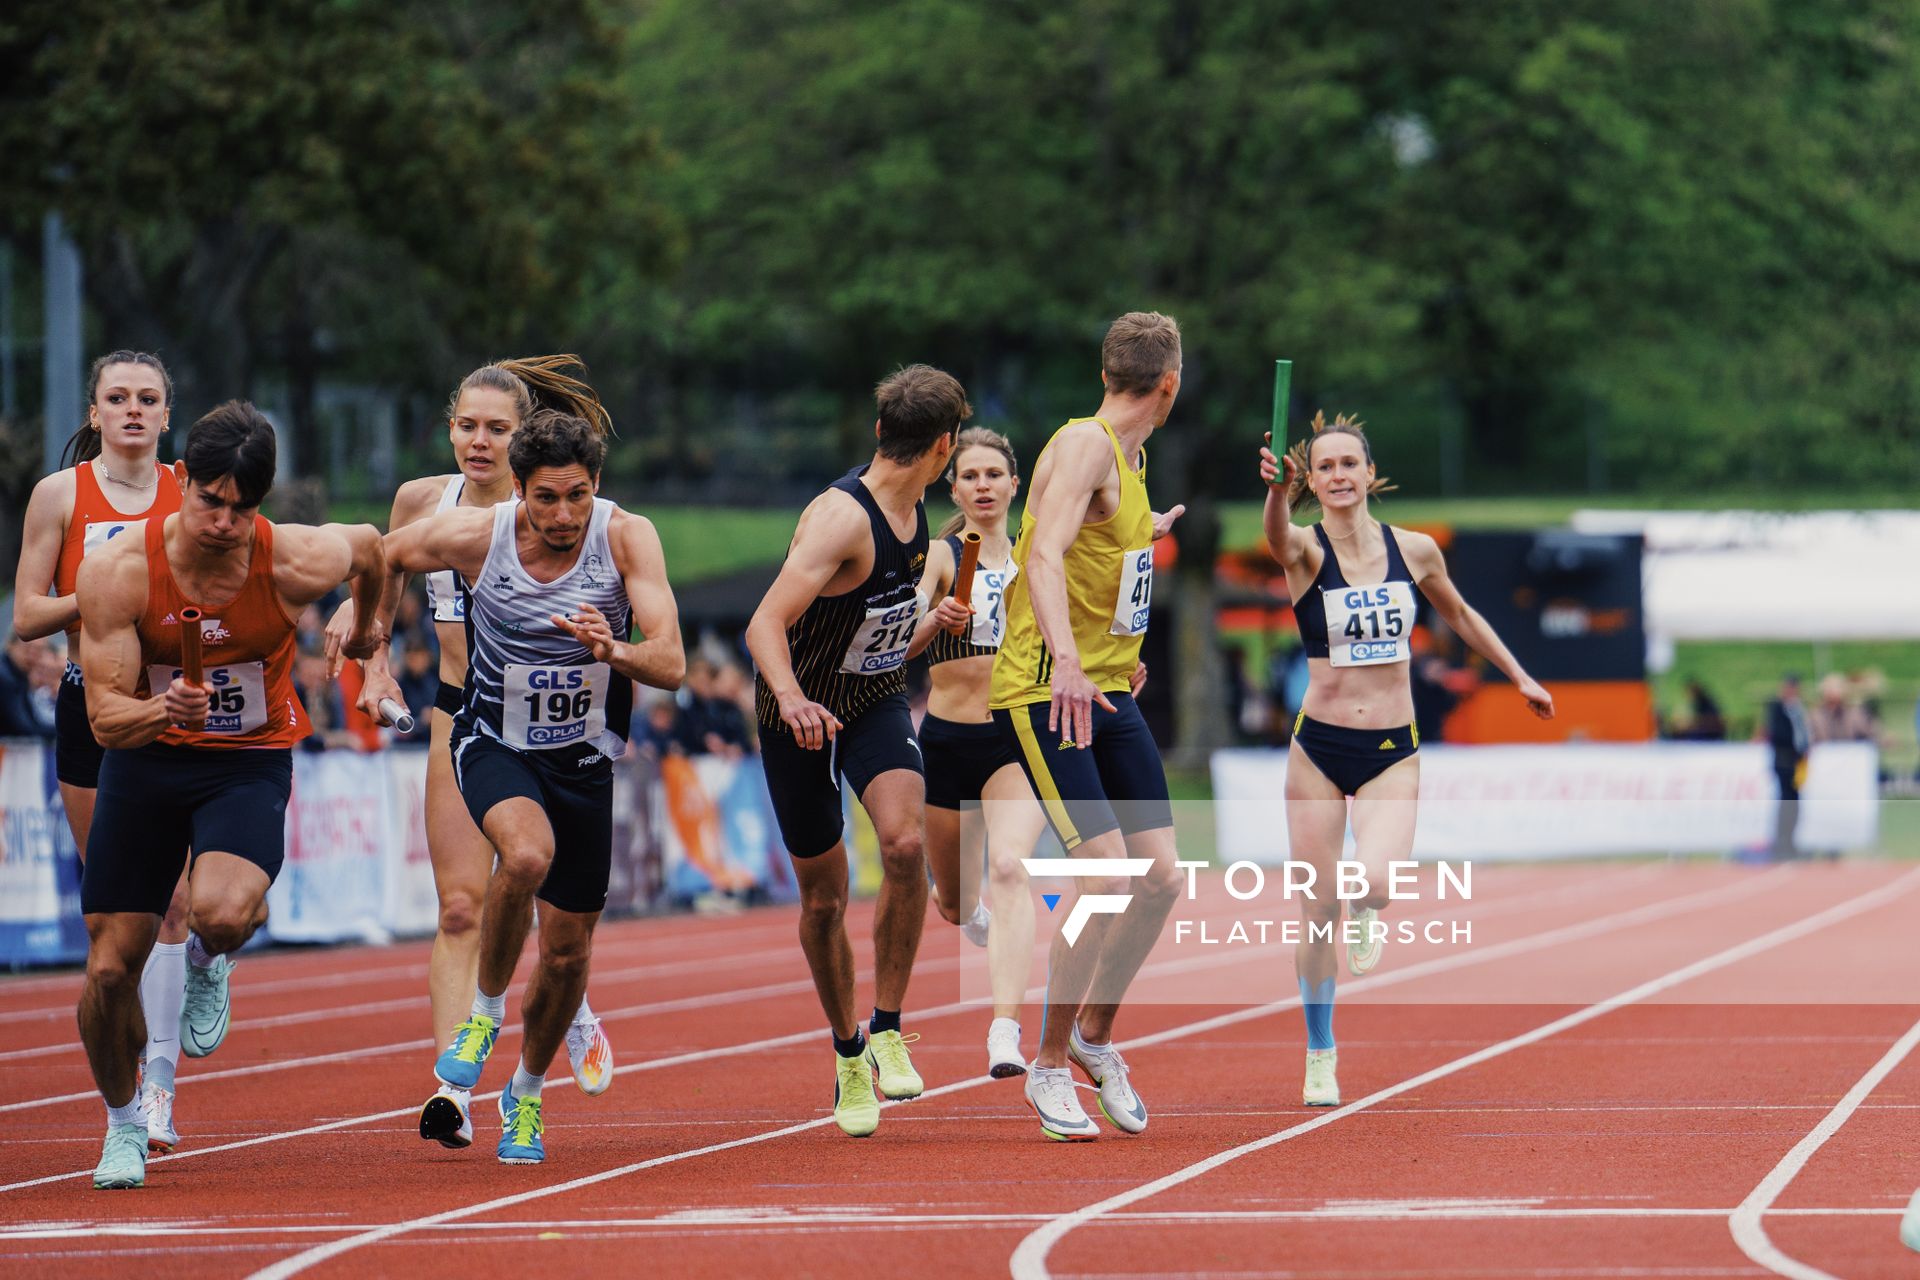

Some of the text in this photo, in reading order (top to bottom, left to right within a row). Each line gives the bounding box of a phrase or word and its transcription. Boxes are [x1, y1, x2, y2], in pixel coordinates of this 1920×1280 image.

[864, 618, 918, 653] 214
[1344, 608, 1403, 640] 415
[64, 660, 85, 685] PR
[524, 689, 592, 722] 196
[204, 718, 239, 728] PLAN
[552, 723, 583, 738] PLAN
